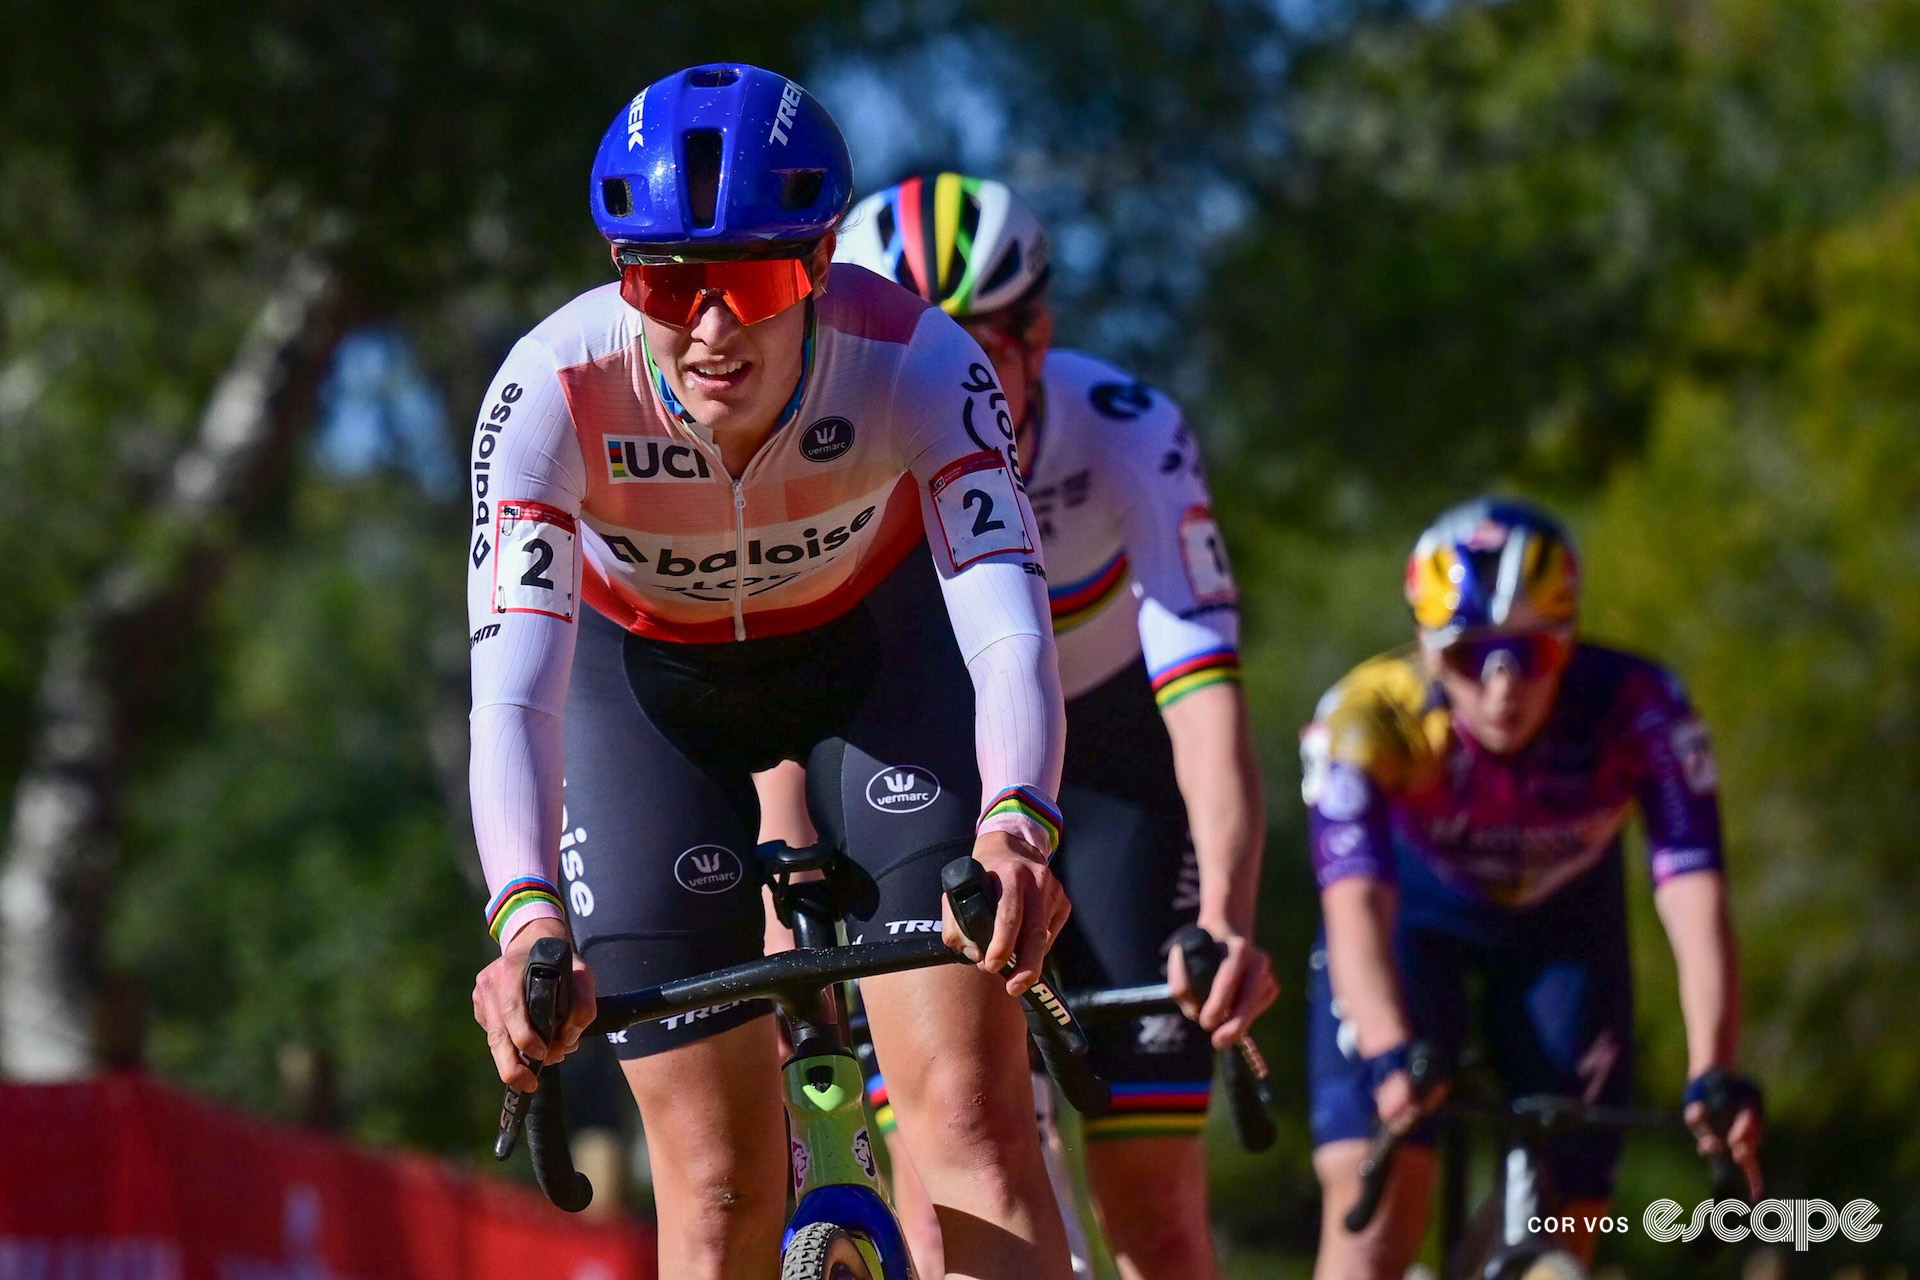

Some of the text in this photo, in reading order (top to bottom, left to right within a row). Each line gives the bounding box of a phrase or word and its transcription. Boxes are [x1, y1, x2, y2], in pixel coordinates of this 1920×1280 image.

[628, 86, 650, 152] REK
[474, 382, 523, 526] baloise
[625, 442, 710, 478] UCI
[808, 441, 846, 456] vermarc
[962, 488, 1006, 537] 2
[656, 505, 876, 576] baloise
[520, 538, 554, 590] 2
[877, 790, 929, 806] vermarc
[688, 872, 736, 888] vermarc
[606, 1030, 629, 1044] EK
